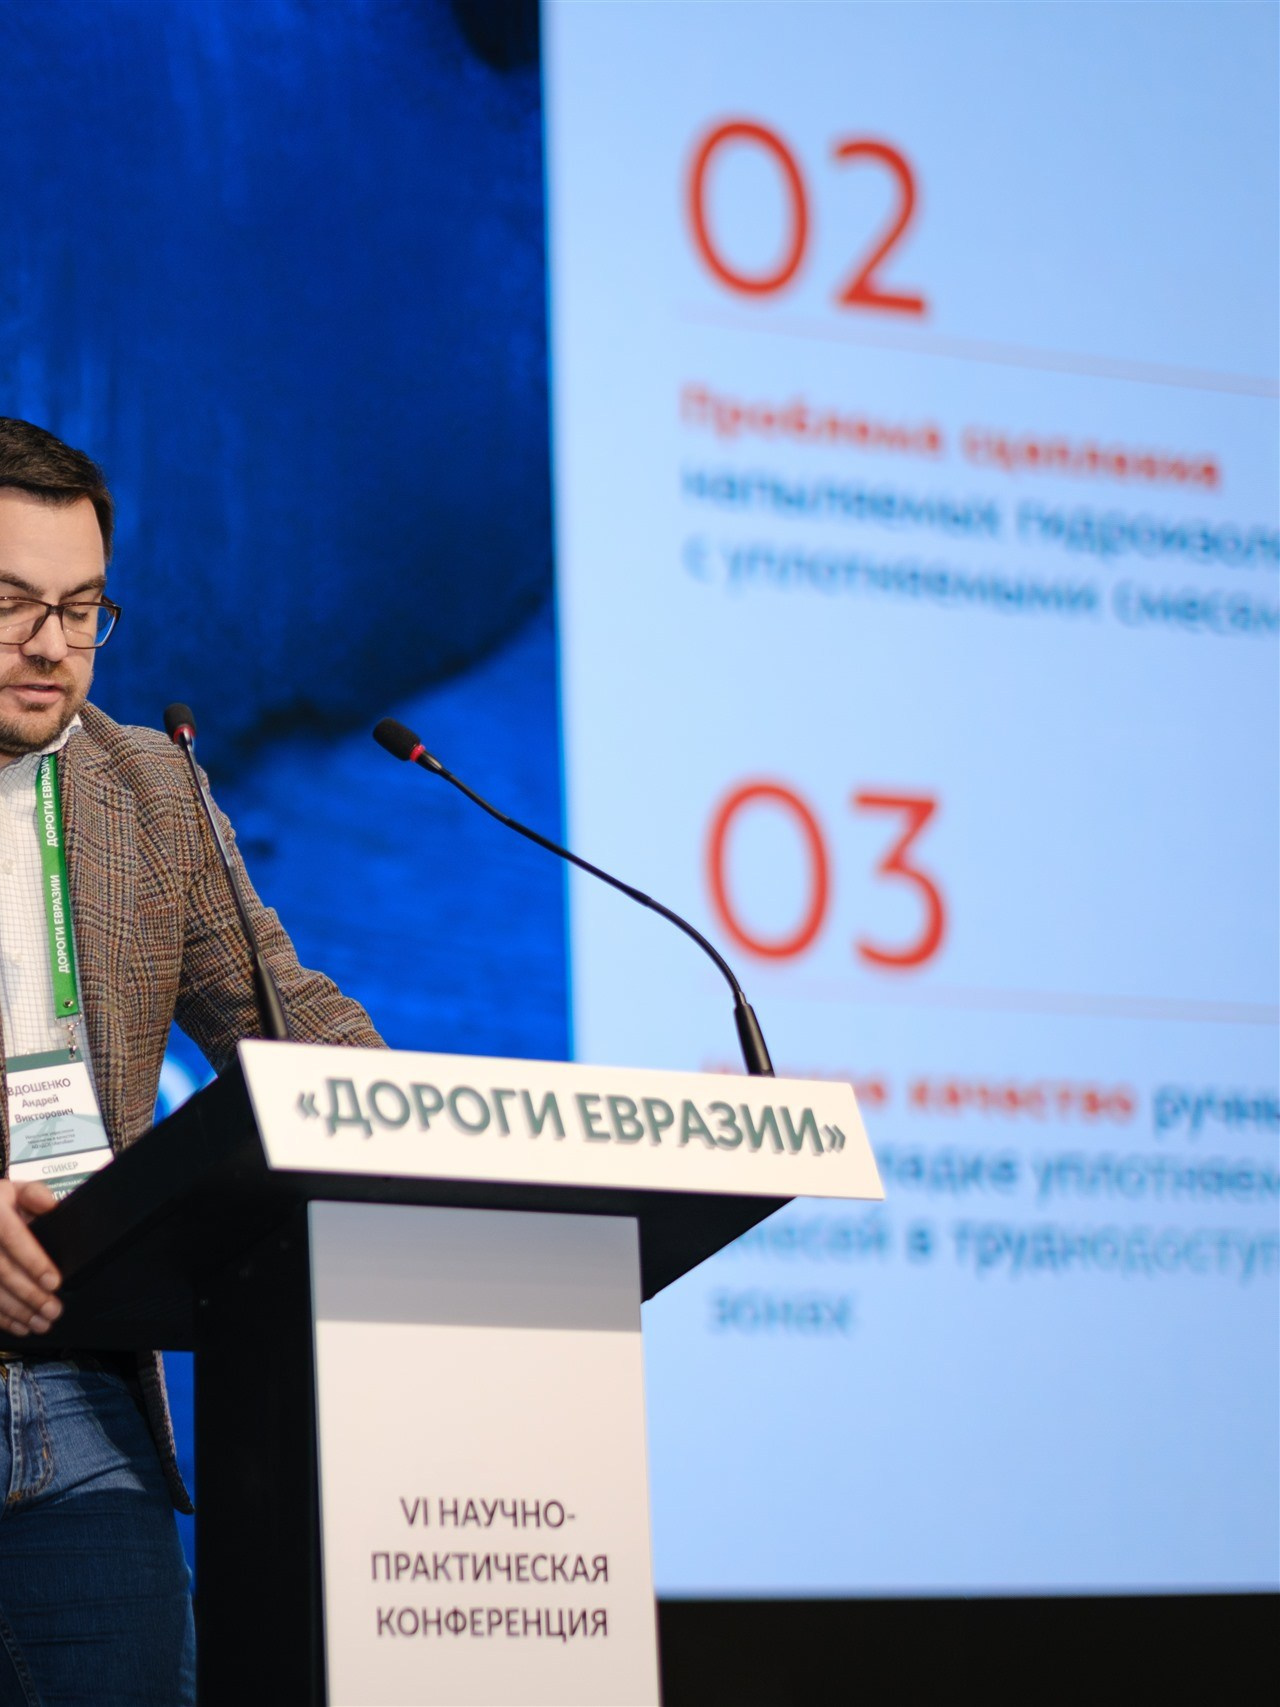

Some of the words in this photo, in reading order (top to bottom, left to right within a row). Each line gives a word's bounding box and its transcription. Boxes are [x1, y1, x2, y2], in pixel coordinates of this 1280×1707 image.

[685, 118, 928, 318] 02
[44, 801, 59, 847] ДОРОГИ
[704, 778, 947, 972] 03
[50, 874, 65, 925] ЕВРАЗИИ
[56, 926, 70, 974] ДОРОГИ
[7, 1077, 71, 1097] ВДОШЕНКО
[22, 1094, 59, 1108] Андрей
[14, 1107, 74, 1124] Викторович
[295, 1076, 566, 1140] «ДОРОГИ
[573, 1092, 846, 1156] ЕВРАЗИИ»
[41, 1161, 78, 1175] СПИКЕР
[400, 1497, 429, 1526] VI
[439, 1498, 576, 1528] НАУЧНО-
[371, 1551, 609, 1583] ПРАКТИЧЕСКАЯ
[376, 1607, 608, 1643] КОНФЕРЕНЦИЯ
